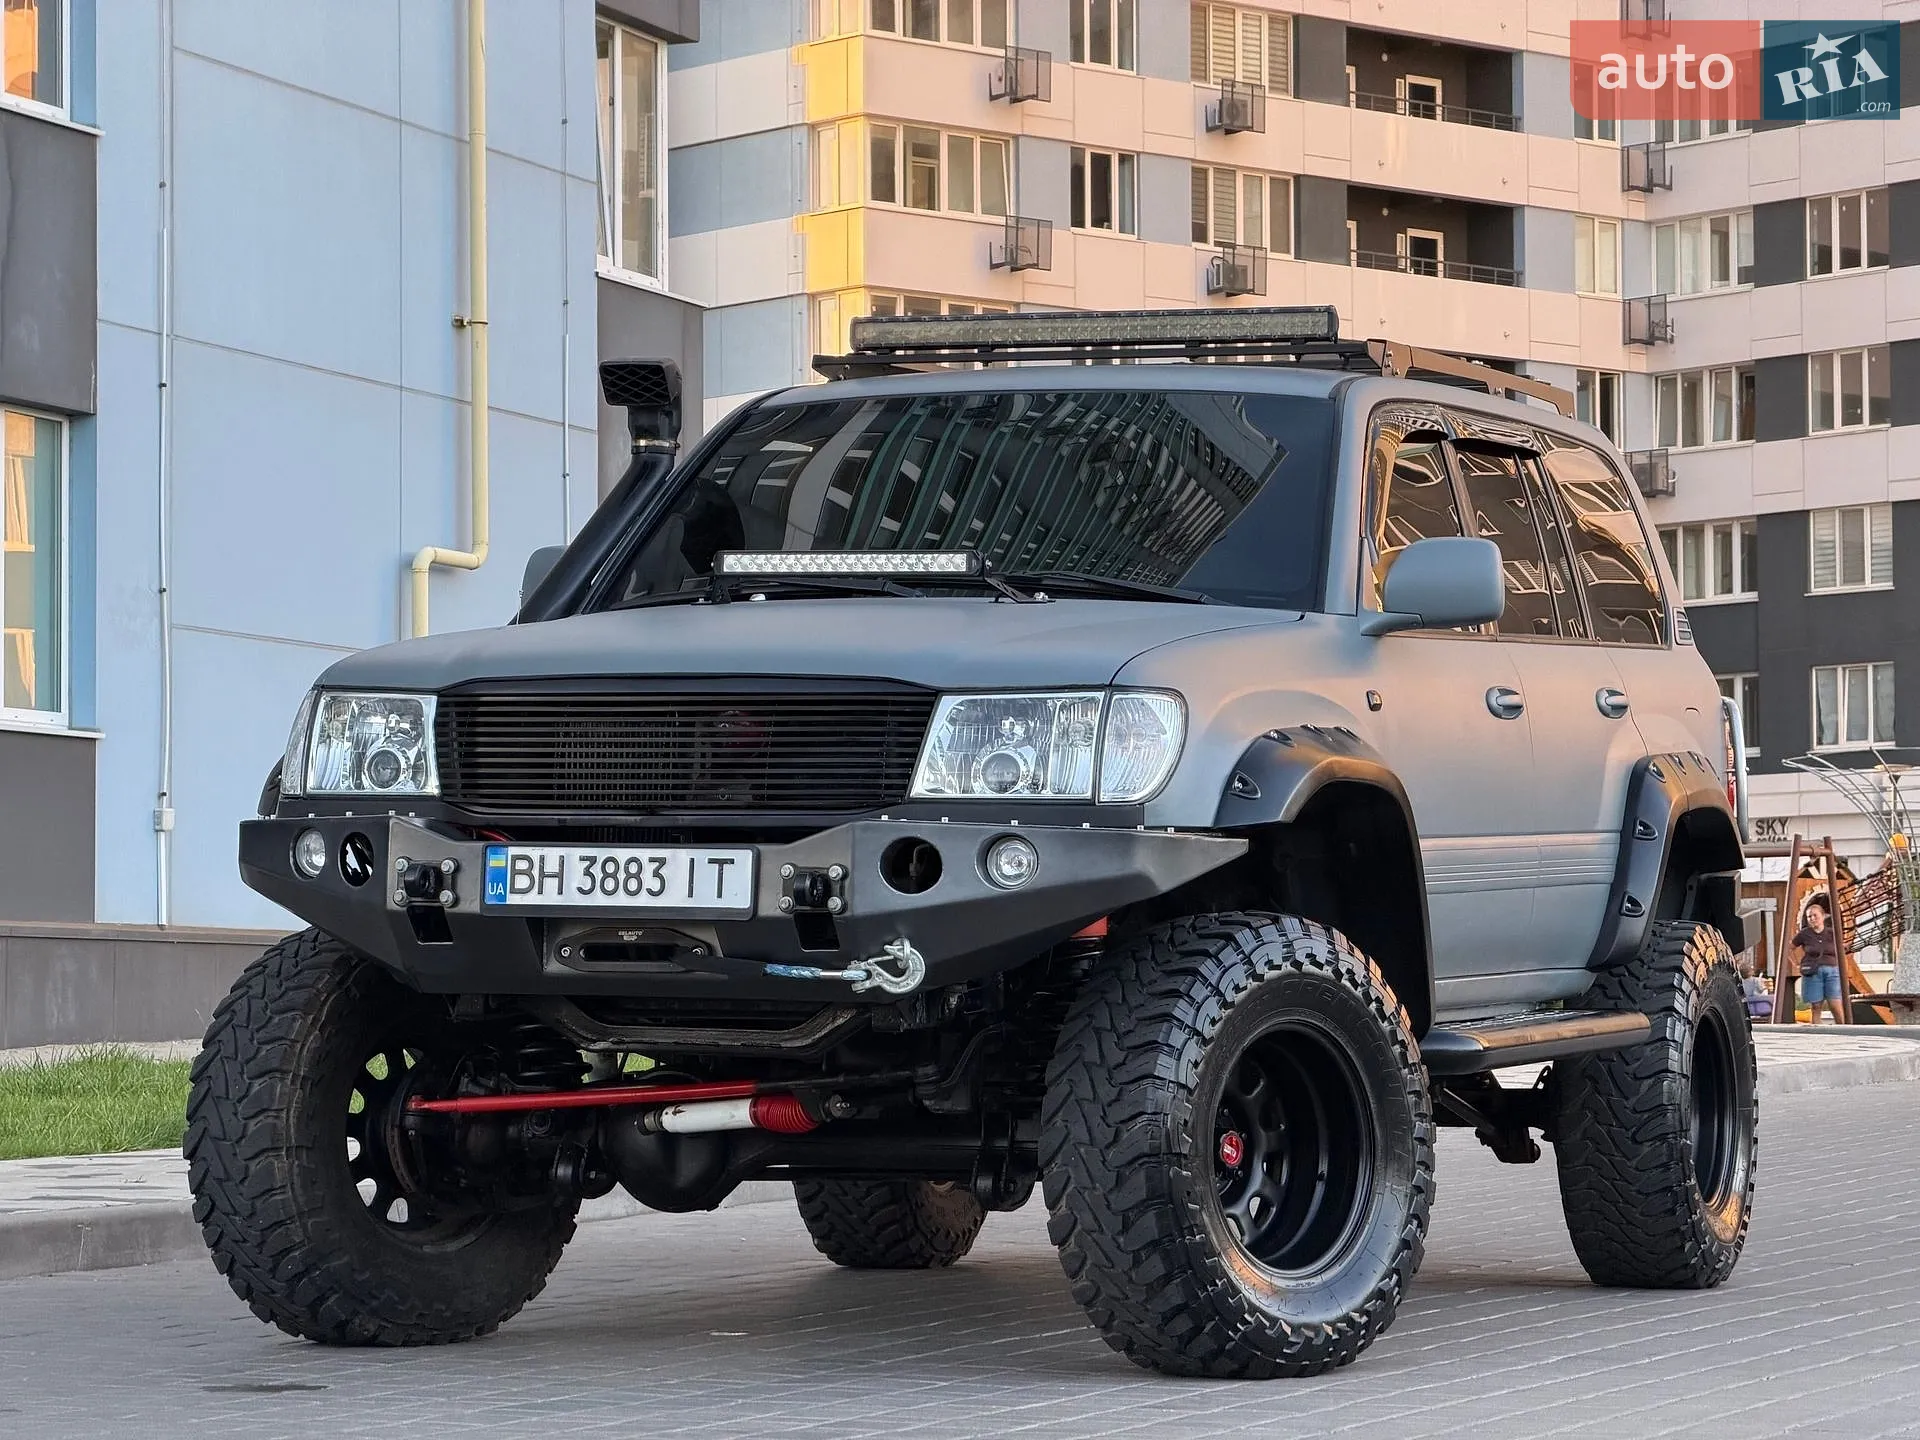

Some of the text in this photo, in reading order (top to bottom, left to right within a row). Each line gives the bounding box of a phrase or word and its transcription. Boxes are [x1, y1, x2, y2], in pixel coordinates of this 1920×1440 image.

[1756, 817, 1789, 836] SKY
[509, 853, 565, 895] BH
[576, 855, 667, 897] 3883
[488, 882, 505, 896] UA
